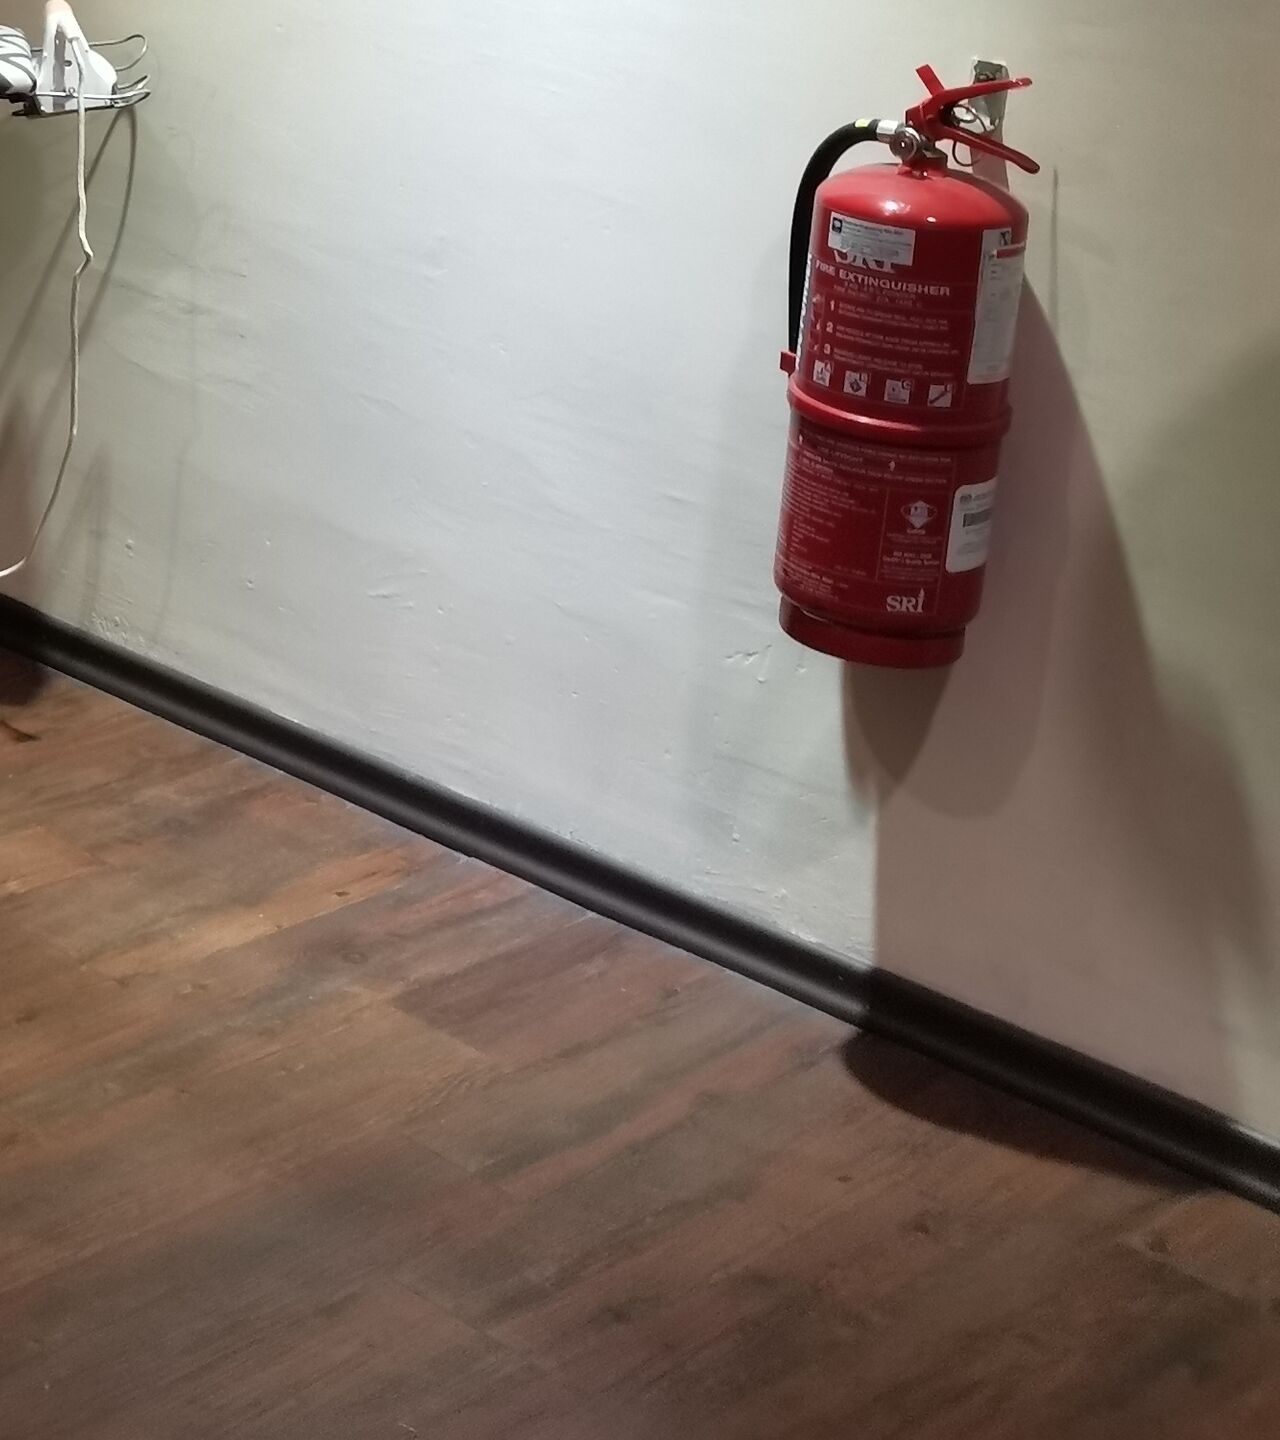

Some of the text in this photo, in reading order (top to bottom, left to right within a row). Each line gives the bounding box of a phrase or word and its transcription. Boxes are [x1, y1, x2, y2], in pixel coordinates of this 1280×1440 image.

[839, 270, 950, 297] EXTINGUISHER
[829, 300, 836, 312] 1
[825, 321, 834, 334] 2
[823, 343, 832, 355] 3
